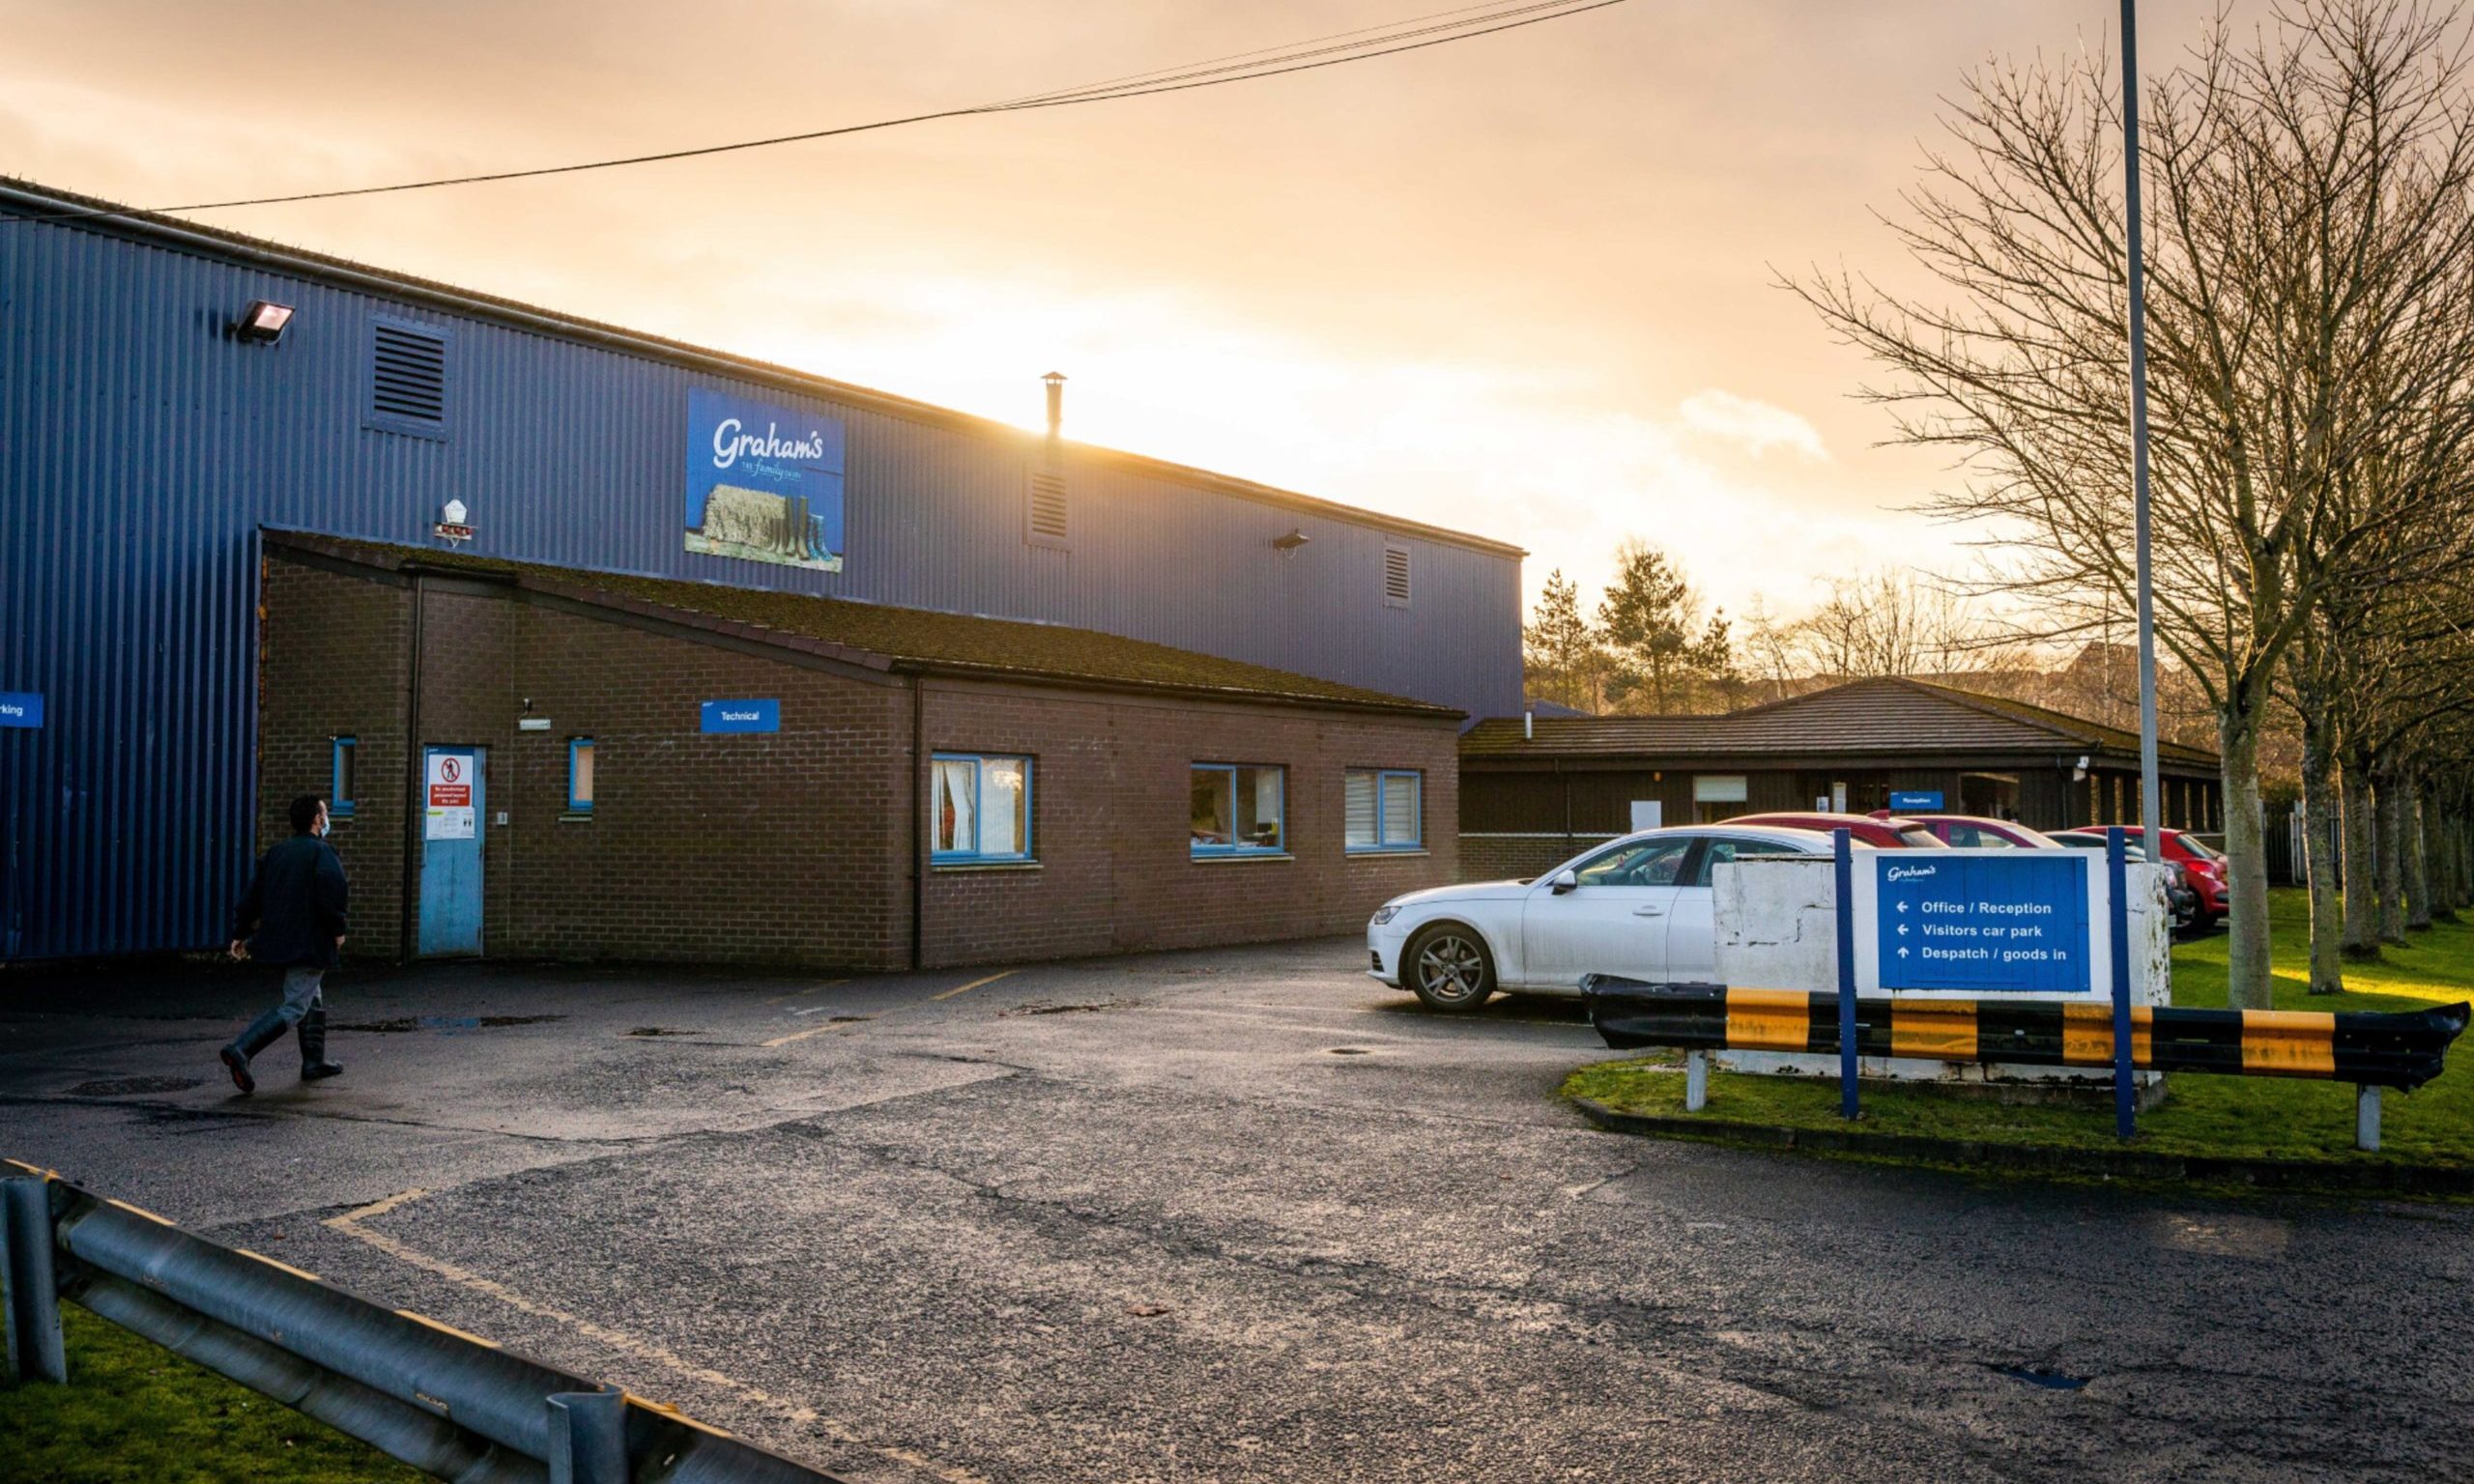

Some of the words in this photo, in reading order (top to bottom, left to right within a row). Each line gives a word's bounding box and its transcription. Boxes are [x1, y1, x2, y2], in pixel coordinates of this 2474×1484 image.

[713, 418, 823, 469] Graham's
[721, 711, 760, 721] Technical
[1887, 865, 1937, 882] Graham's
[1921, 901, 1965, 914] Office
[1969, 901, 1974, 914] /
[1978, 901, 2053, 917] Reception
[1923, 924, 1977, 937] Visitors
[1982, 926, 2006, 937] car
[2010, 925, 2043, 940] park
[1922, 947, 1989, 962] Despatch
[1993, 947, 1999, 960] /
[2002, 948, 2049, 963] goods
[2053, 948, 2067, 961] in
